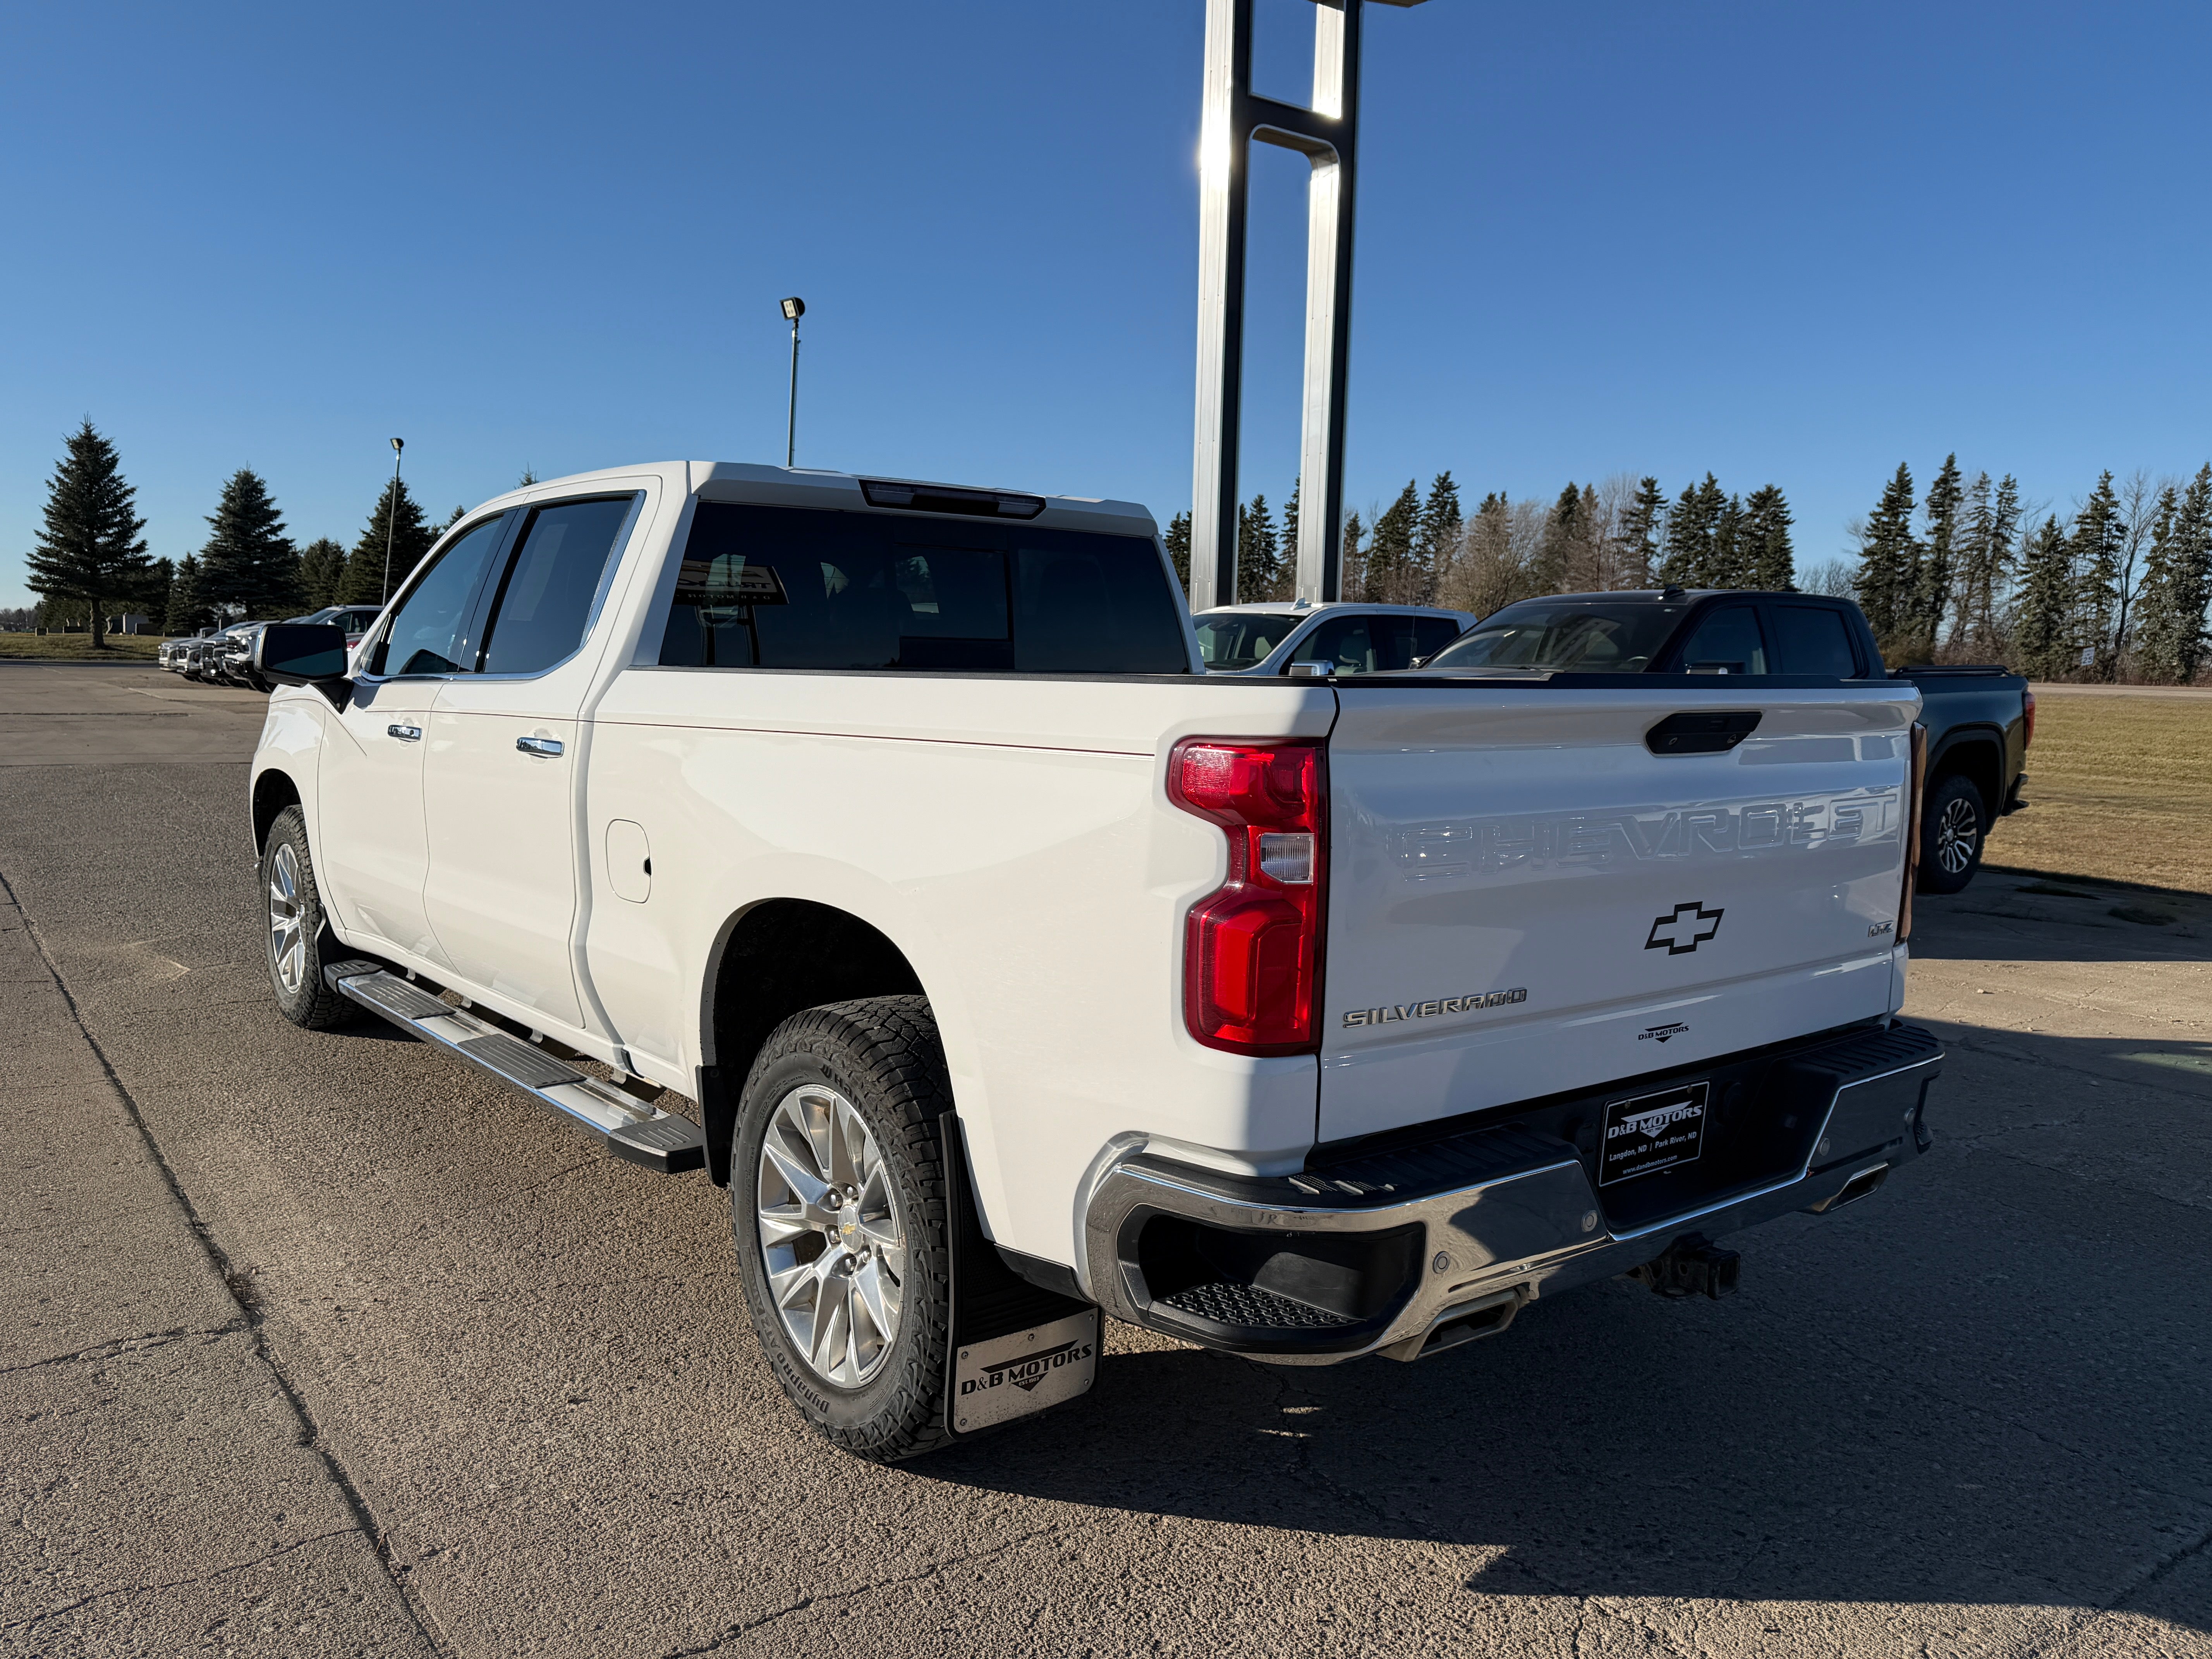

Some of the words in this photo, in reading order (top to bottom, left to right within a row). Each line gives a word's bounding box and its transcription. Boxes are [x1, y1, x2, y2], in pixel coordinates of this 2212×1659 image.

[2083, 656, 2092, 664] 25
[1401, 795, 1897, 881] CHEVROLET
[1868, 920, 1893, 937] LTZ
[1343, 987, 1527, 1028] SILVERADO
[1655, 1025, 1689, 1037] MOTORS
[1608, 1122, 1637, 1139] D&B
[1640, 1105, 1703, 1130] MOTORS
[1609, 1149, 1637, 1161] Langdon,
[1638, 1144, 1647, 1153] ND
[1655, 1139, 1668, 1149] Park
[1670, 1135, 1686, 1144] River,
[1688, 1132, 1697, 1140] ND
[1623, 1155, 1677, 1175] www.dandbmotors.com
[962, 1372, 1004, 1396] D&B
[1008, 1343, 1092, 1382] MOTORS
